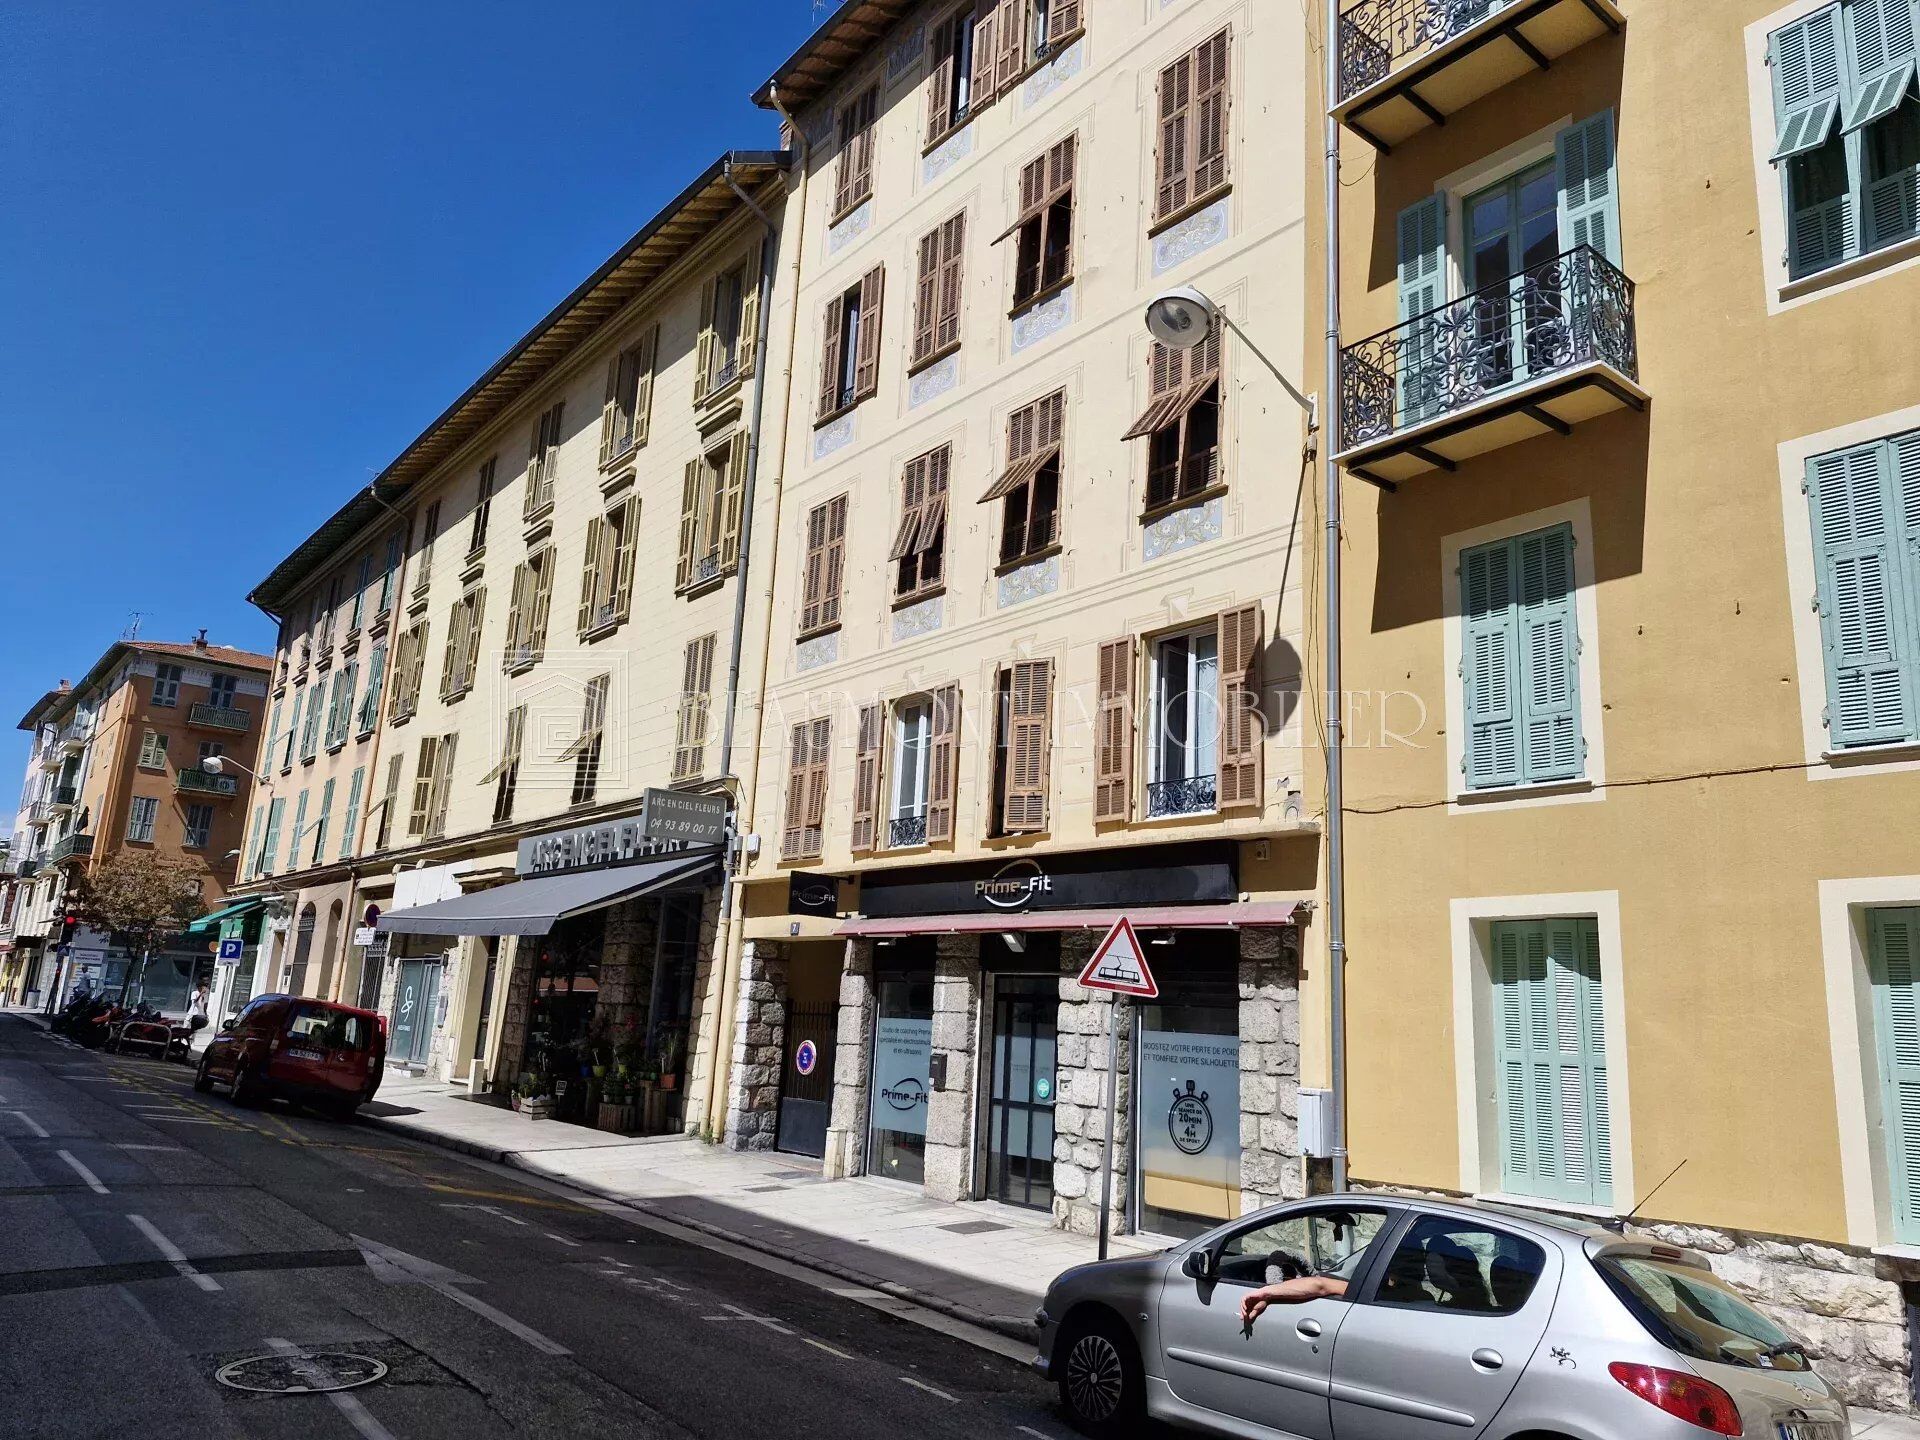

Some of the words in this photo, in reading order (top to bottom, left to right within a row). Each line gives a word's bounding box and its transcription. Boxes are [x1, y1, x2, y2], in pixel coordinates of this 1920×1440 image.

[651, 797, 666, 807] ARC
[668, 799, 677, 808] EN
[678, 800, 693, 811] CIEL
[695, 803, 720, 814] FLEURS
[651, 817, 663, 829] 04
[665, 819, 677, 830] 93
[678, 821, 691, 832] 89
[693, 823, 705, 834] 00
[707, 825, 718, 835] 17
[975, 874, 1052, 895] Prime-Fit
[792, 890, 836, 902] Prime-Fit
[226, 943, 237, 956] P
[1143, 1042, 1170, 1052] BOOSTEZ
[1171, 1043, 1190, 1052] VOTRE
[1191, 1045, 1211, 1054] PERTE
[1212, 1047, 1221, 1055] DE
[1143, 1053, 1150, 1061] ET
[1152, 1054, 1178, 1064] TONIFIEZ
[1179, 1056, 1199, 1065] VOTRE
[1200, 1058, 1239, 1068] SILHOUETTE
[882, 1088, 928, 1104] Prime-Fit
